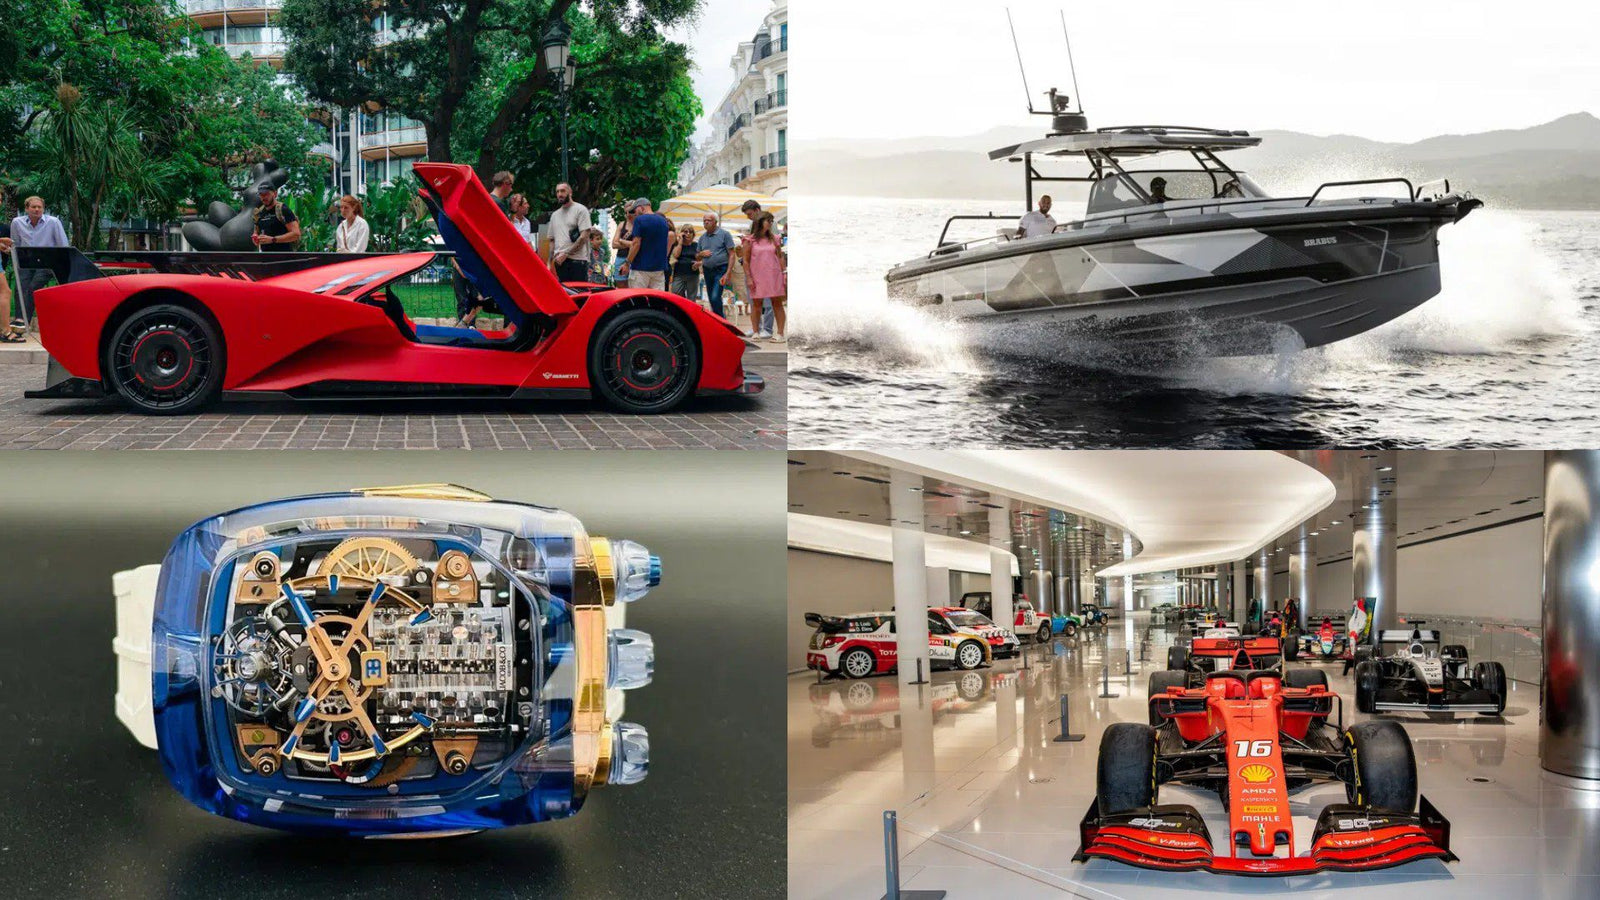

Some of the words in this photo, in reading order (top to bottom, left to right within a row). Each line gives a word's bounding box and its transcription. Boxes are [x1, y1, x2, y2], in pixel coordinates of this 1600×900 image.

[1304, 237, 1337, 246] BRABUS
[1234, 739, 1273, 758] 16
[1160, 838, 1199, 847] V-Power
[1334, 837, 1374, 846] V-Power
